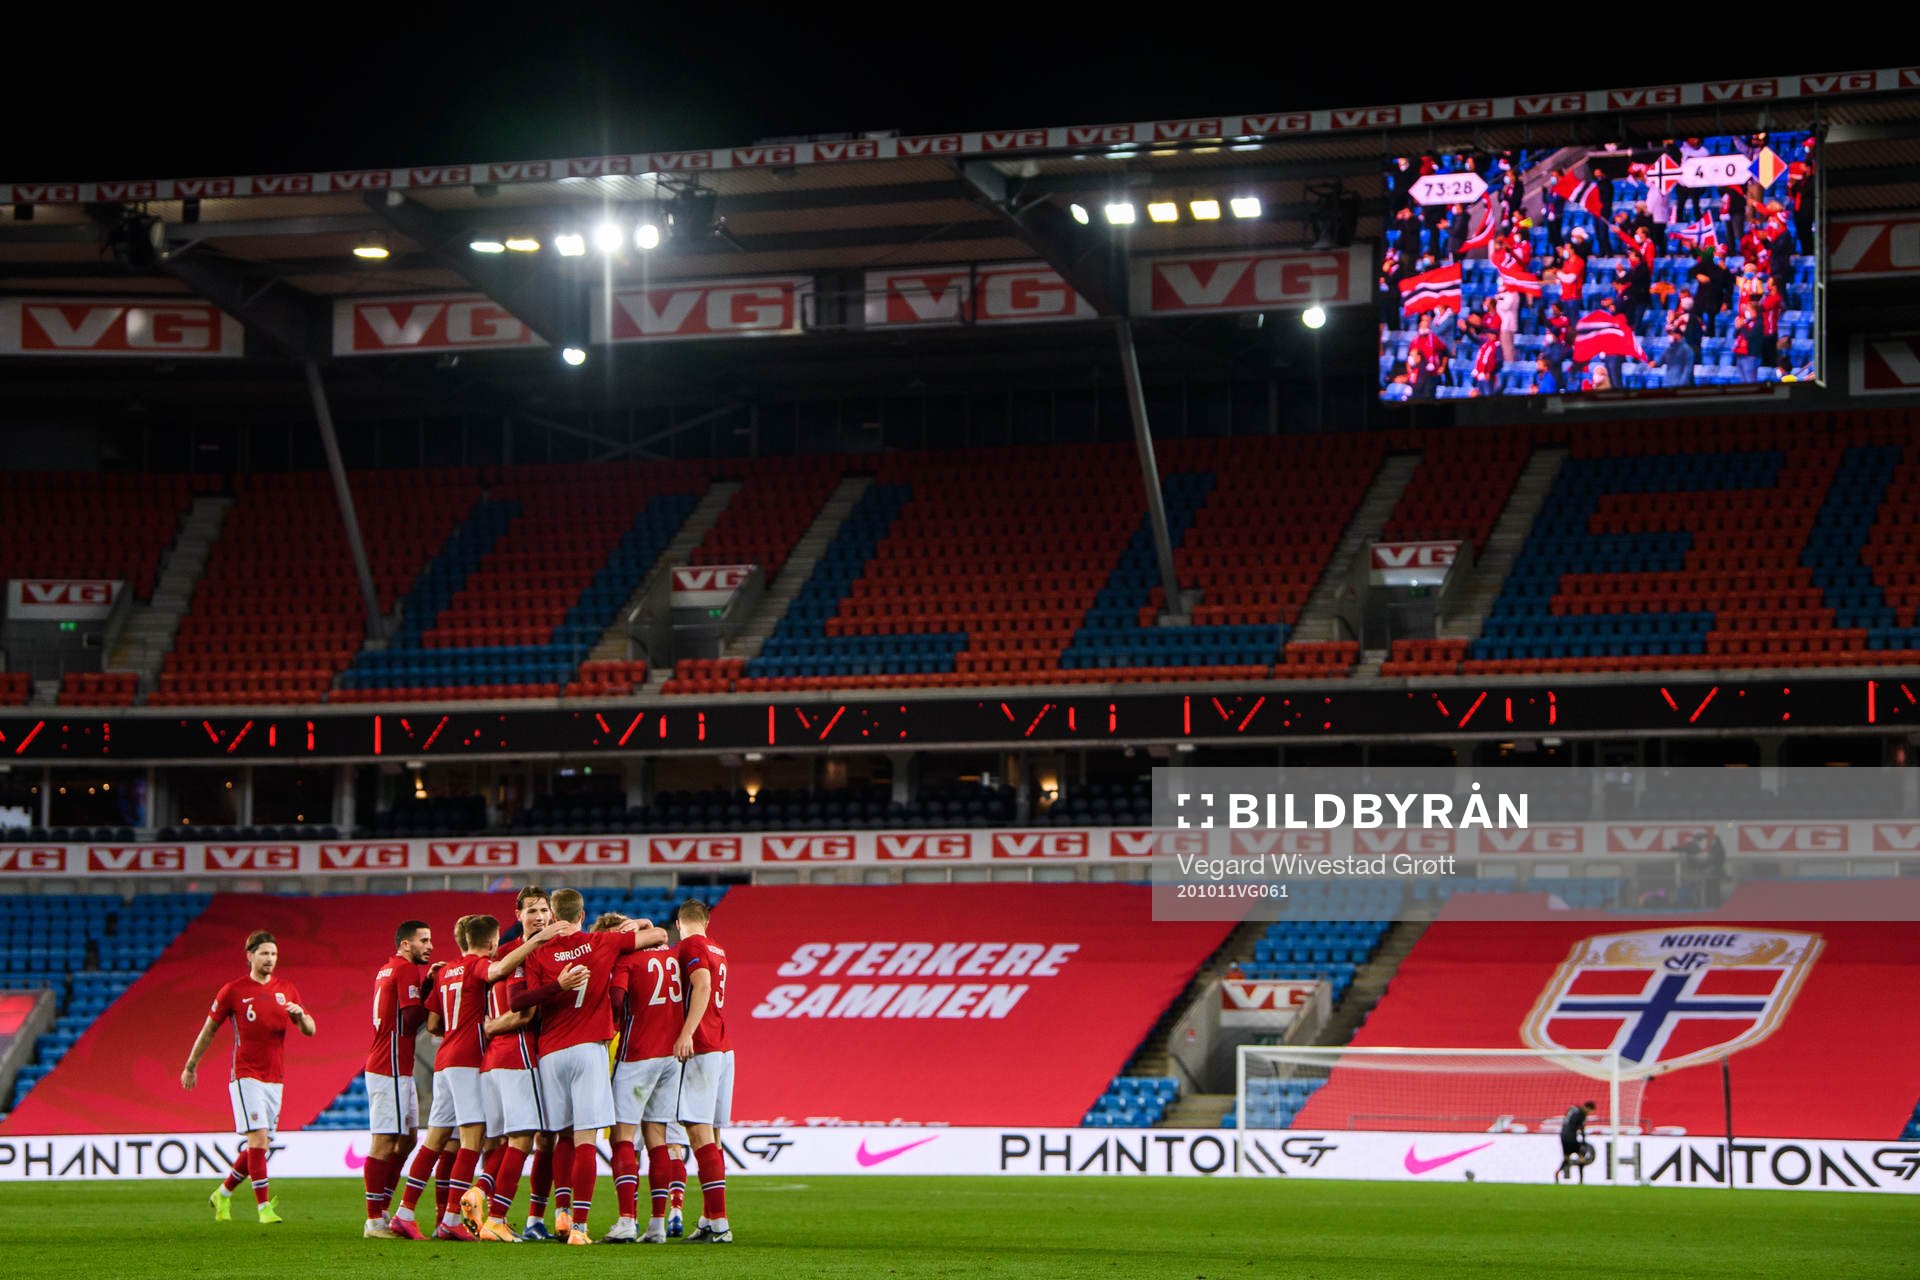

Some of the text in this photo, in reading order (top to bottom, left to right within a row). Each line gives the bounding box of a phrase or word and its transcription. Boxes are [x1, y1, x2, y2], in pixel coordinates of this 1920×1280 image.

[1706, 82, 1772, 100] VG
[1803, 74, 1871, 92] VG
[1515, 96, 1582, 114] VG
[1611, 88, 1676, 106] VG
[1333, 109, 1396, 126] VG
[1424, 102, 1489, 119] VG
[1155, 121, 1217, 138] VG
[1246, 114, 1305, 133] VG
[984, 131, 1043, 148] VG
[1069, 127, 1130, 143] VG
[817, 143, 873, 159] VG
[900, 138, 957, 154] VG
[653, 153, 708, 169] VG
[735, 148, 790, 165] VG
[413, 168, 467, 184] VG
[493, 164, 546, 180] VG
[570, 159, 628, 175] VG
[174, 181, 230, 196] VG
[255, 176, 309, 192] VG
[333, 172, 387, 188] VG
[1424, 181, 1473, 197] 73:28
[16, 185, 74, 200] VG
[100, 183, 152, 198] VG
[1158, 256, 1340, 305] VG
[892, 273, 1066, 320] VG
[616, 287, 784, 334] VG
[28, 306, 210, 348] VG
[360, 302, 522, 346] VG
[1377, 546, 1456, 566] VG
[677, 570, 748, 589] VG
[27, 583, 106, 602] VG
[880, 836, 967, 858] VG
[996, 834, 1084, 857] VG
[1116, 831, 1204, 855] VG
[1235, 831, 1324, 853] VG
[1356, 830, 1450, 852] VG
[1483, 828, 1578, 850] VG
[1611, 827, 1706, 850] VG
[1743, 827, 1842, 849] VG
[94, 848, 180, 868] VG
[210, 847, 293, 868] VG
[323, 846, 405, 867] VG
[433, 844, 514, 864] VG
[542, 842, 624, 863] VG
[653, 840, 736, 861] VG
[766, 838, 850, 859] VG
[1660, 933, 1742, 948] NORGE
[554, 943, 592, 962] SØRLOTH
[777, 942, 1080, 977] STERKERE
[648, 956, 683, 1006] 23
[715, 963, 727, 1009] 3
[752, 984, 1029, 1019] SAMMEN
[1223, 984, 1314, 1009] VG
[246, 1004, 257, 1022] 6
[440, 981, 463, 1032] 17
[1000, 1134, 1286, 1174] PHANTOM
